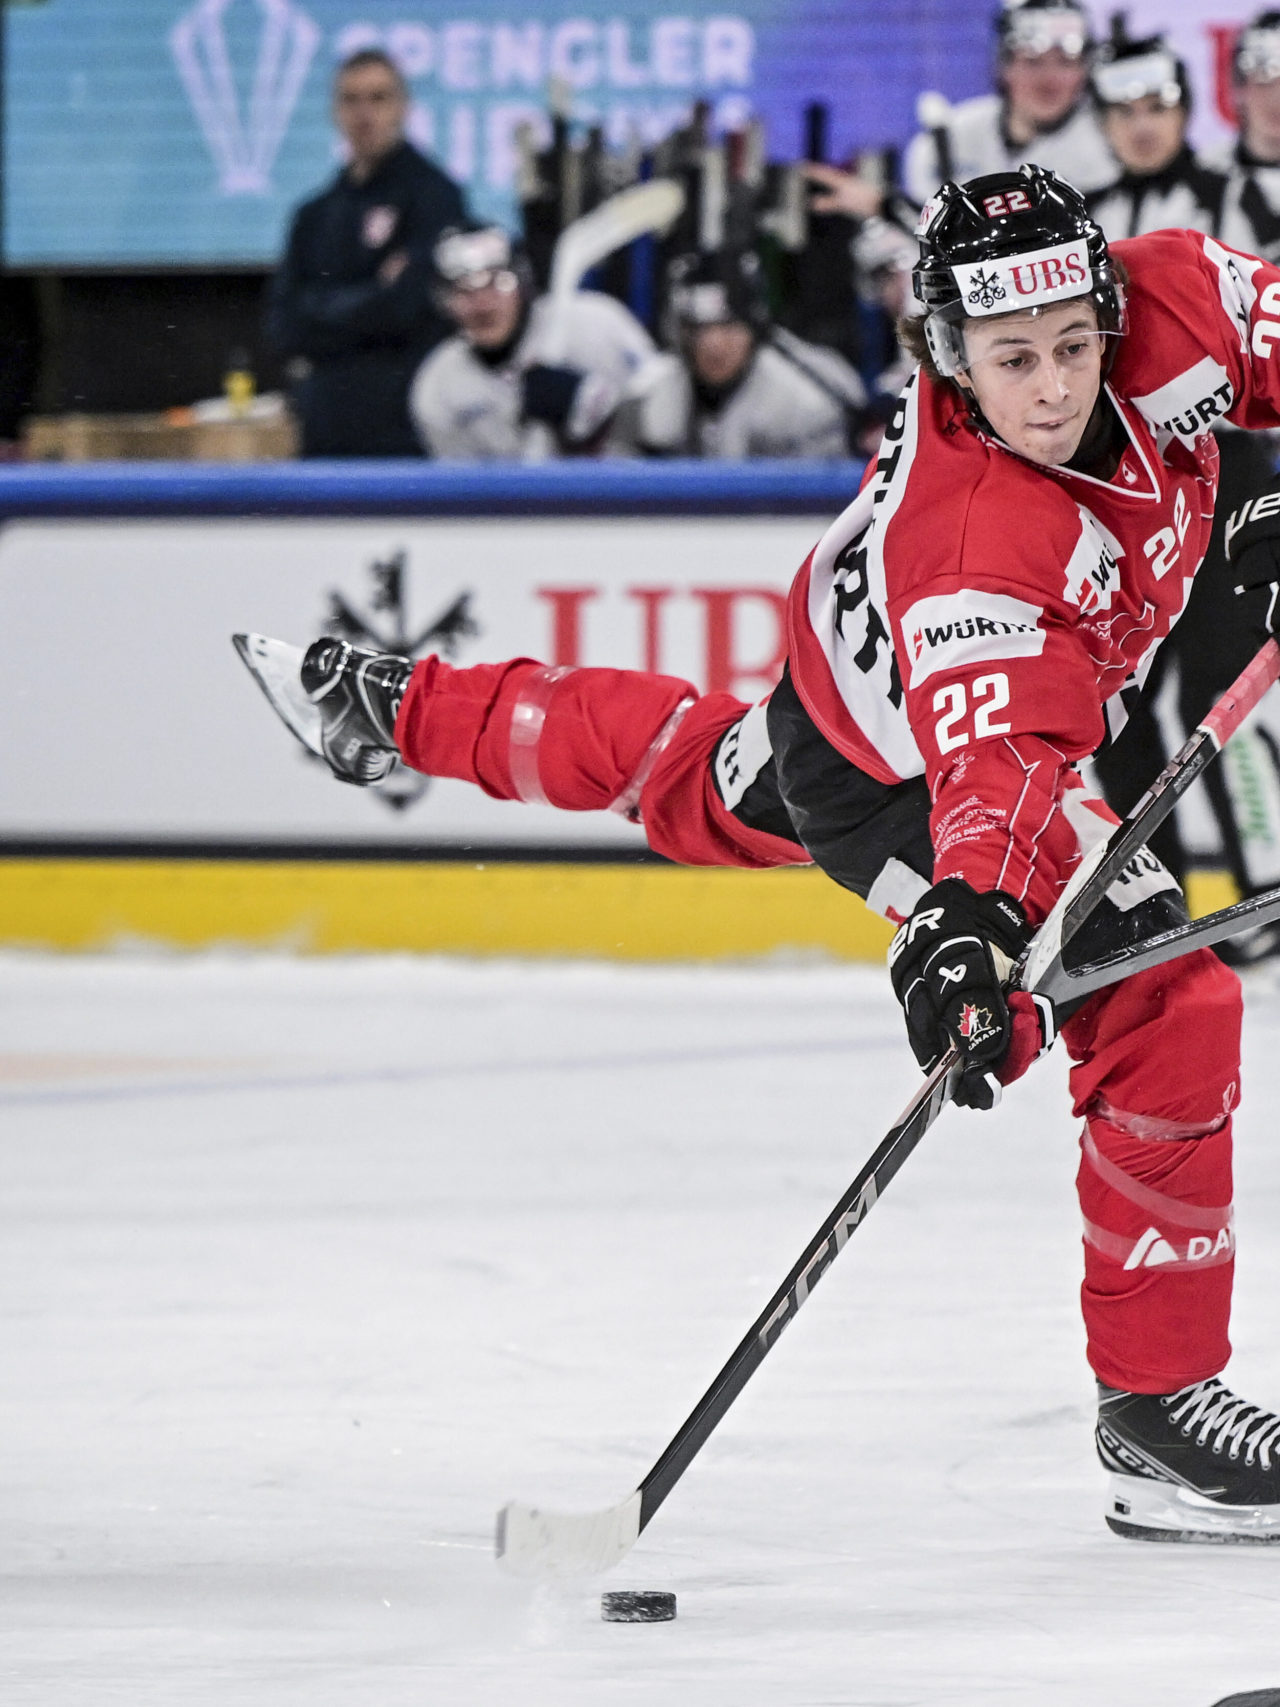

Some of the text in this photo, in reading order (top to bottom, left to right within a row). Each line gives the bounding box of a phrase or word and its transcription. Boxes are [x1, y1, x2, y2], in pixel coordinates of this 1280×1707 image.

[983, 190, 1031, 218] 22
[1009, 253, 1086, 295] UBS
[1162, 382, 1230, 436] ÜRT
[1143, 487, 1192, 582] 22
[933, 672, 1011, 756] 22
[968, 1026, 1003, 1050] CANADA
[759, 1172, 878, 1349] CCM
[1187, 1226, 1232, 1261] DA
